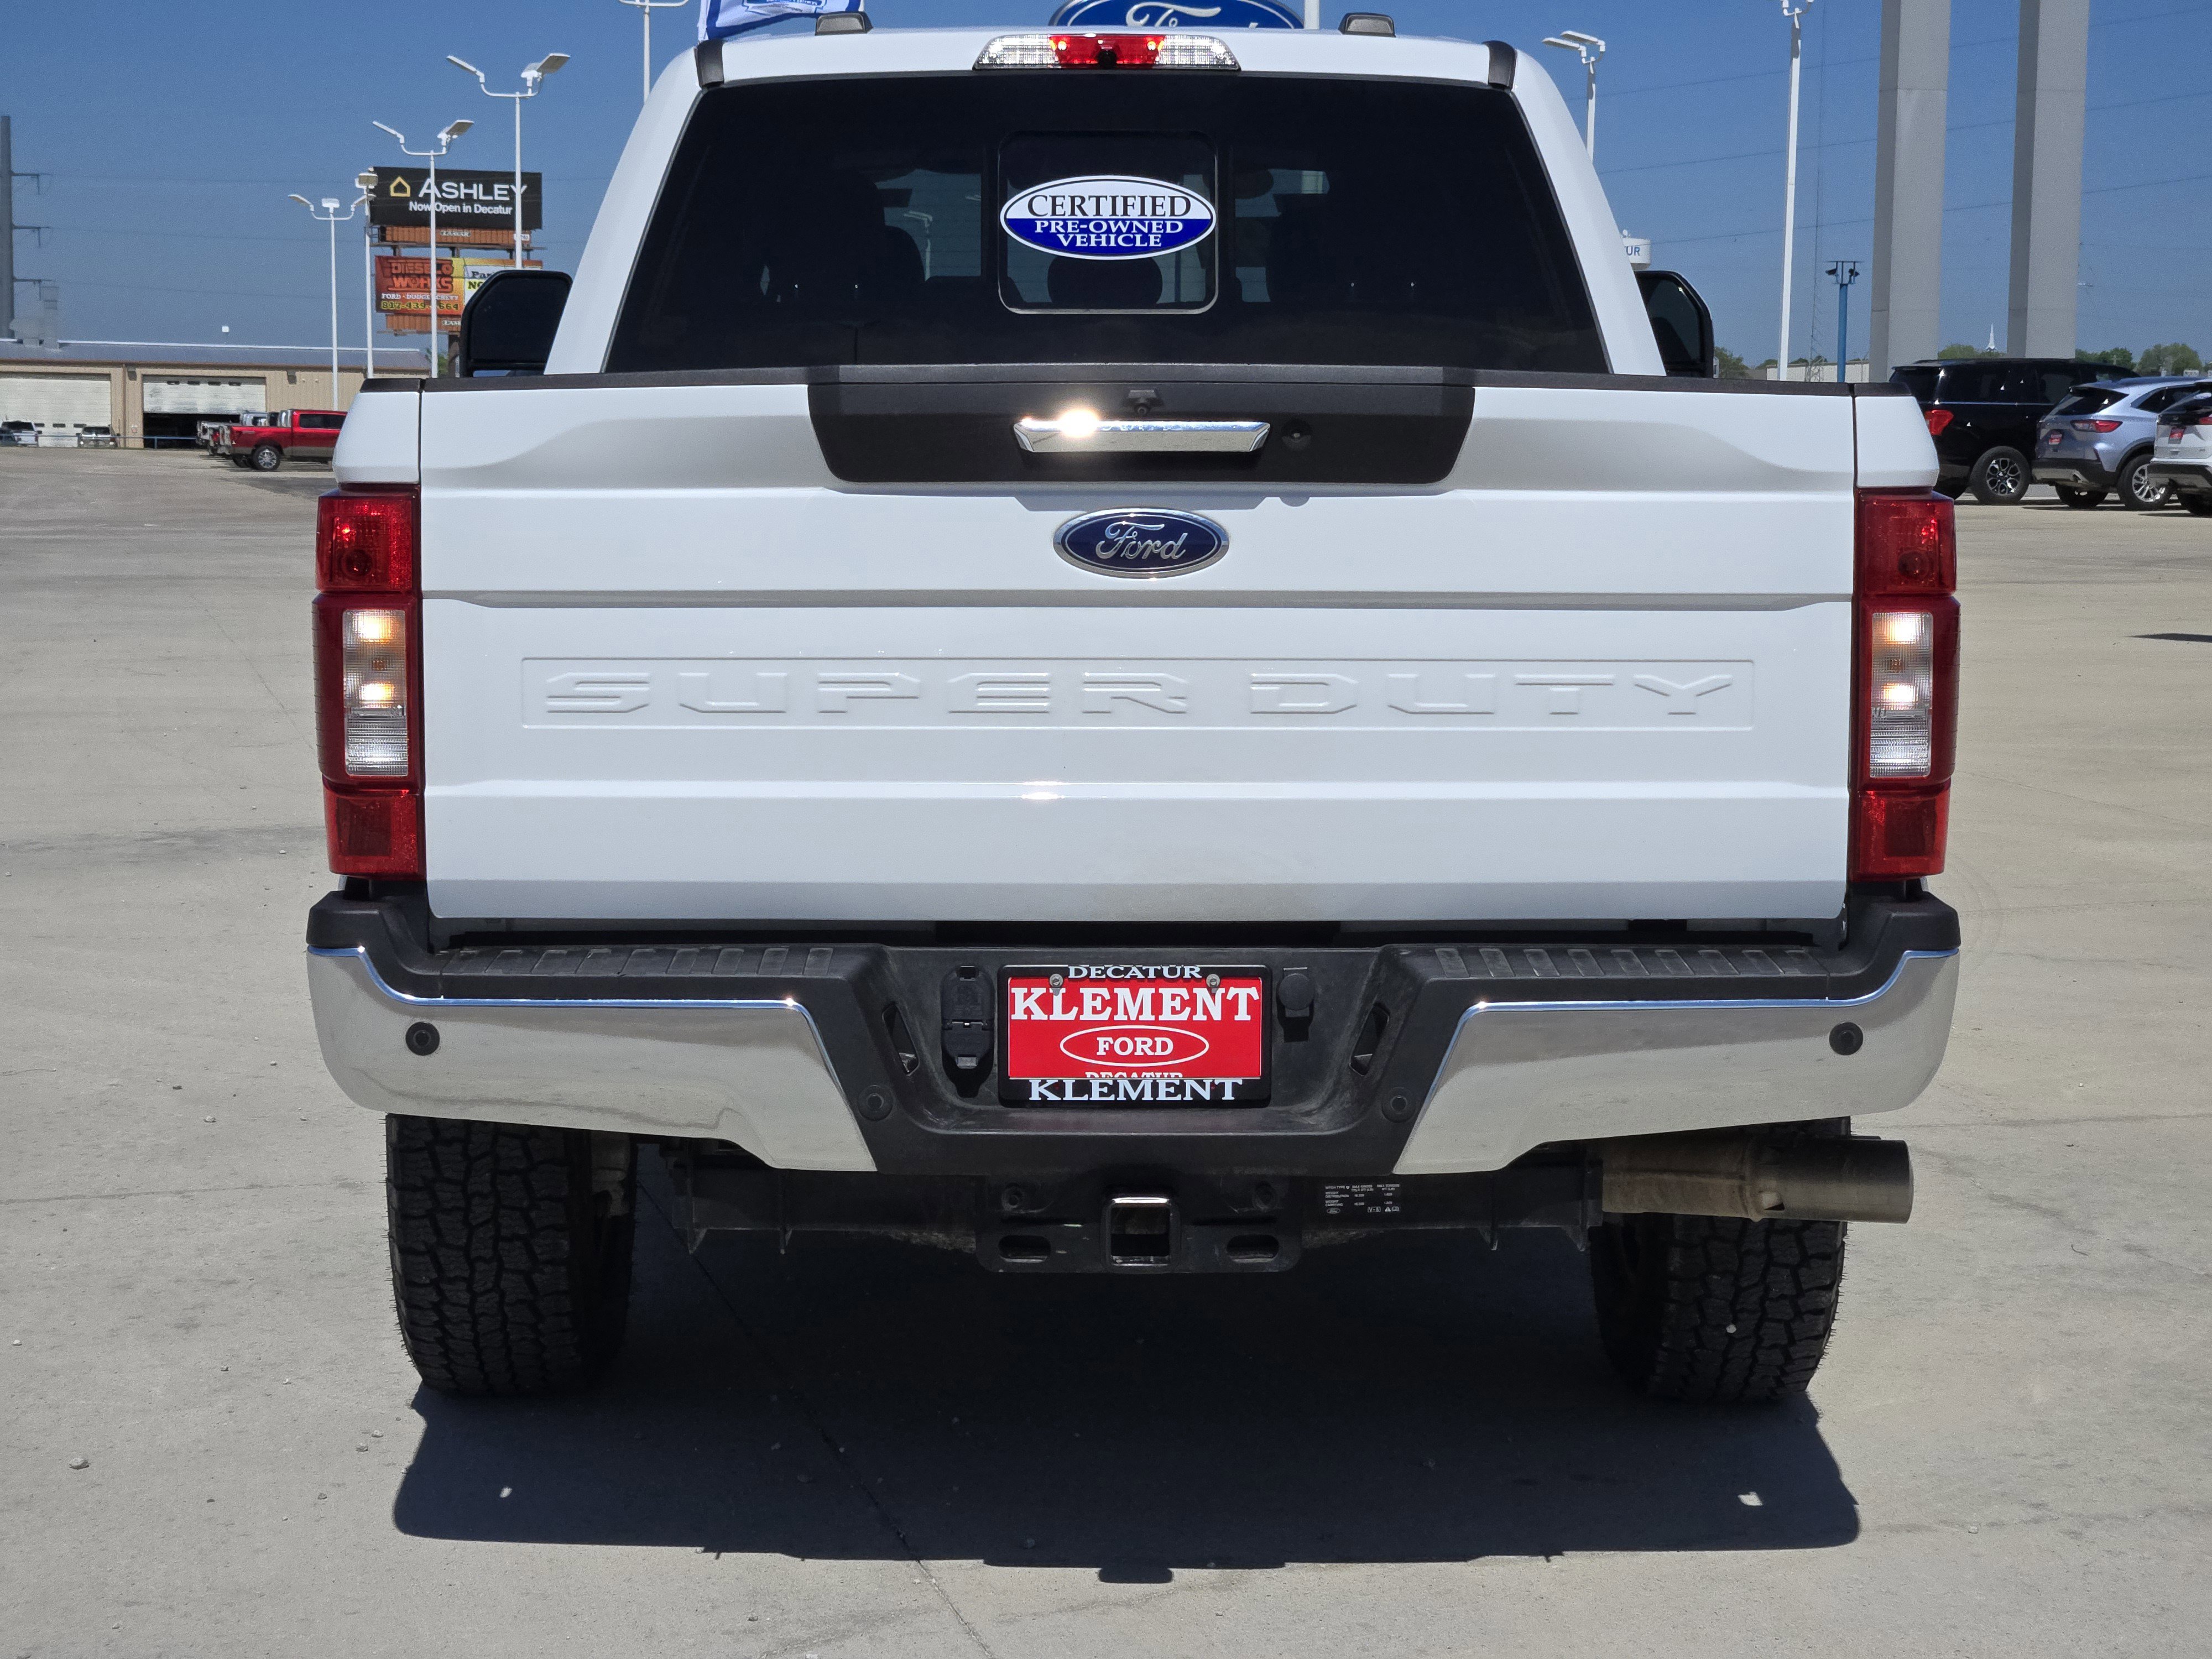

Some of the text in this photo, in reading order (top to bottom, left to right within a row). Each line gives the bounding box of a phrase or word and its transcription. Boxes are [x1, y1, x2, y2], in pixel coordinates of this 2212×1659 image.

[419, 178, 528, 200] ASHLEY
[409, 201, 513, 215] Now Open in Decatur
[1027, 195, 1191, 217] CERTIFIED
[1035, 220, 1183, 233] PRE-OWNED
[1057, 234, 1162, 247] VEHICLE
[1625, 246, 1640, 256] UR
[1095, 521, 1188, 560] Ford
[546, 671, 1733, 714] SUPER DUTY
[1068, 966, 1202, 979] DECATUR
[1010, 987, 1260, 1021] KLEMENT
[1096, 1037, 1174, 1056] FORD
[1029, 1079, 1243, 1101] KLEMENT
